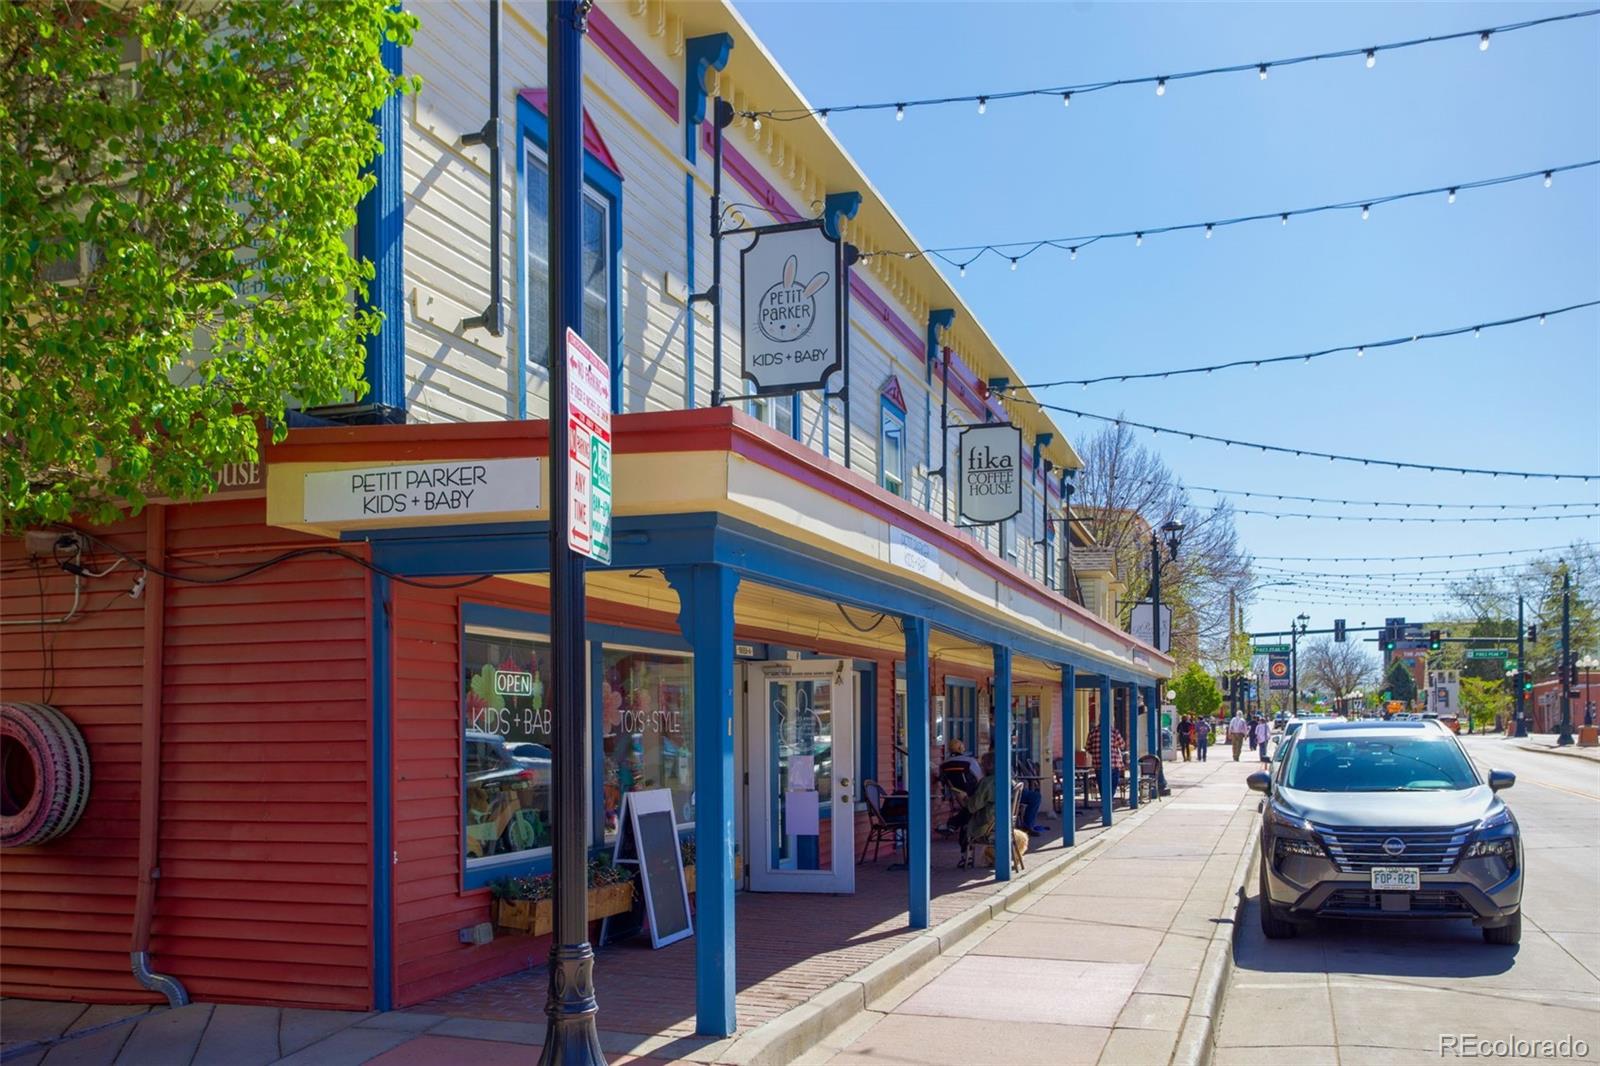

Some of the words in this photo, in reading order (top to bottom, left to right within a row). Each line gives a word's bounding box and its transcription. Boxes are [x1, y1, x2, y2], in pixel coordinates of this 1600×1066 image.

[752, 352, 783, 367] KIDS
[794, 348, 828, 363] BABY
[592, 445, 598, 479] 2
[968, 446, 1013, 470] fika
[351, 471, 402, 493] PETIT
[406, 465, 487, 490] PARKER
[575, 470, 586, 496] ANY
[968, 472, 1013, 484] COFFEE
[969, 482, 1012, 496] HOUSE
[363, 493, 406, 514] KIDS
[412, 497, 420, 506] +
[424, 489, 474, 511] BABY
[574, 498, 586, 525] TIME
[497, 674, 530, 692] OPEN
[472, 707, 510, 735] KIDS
[513, 714, 521, 728] +
[524, 708, 552, 735] BAB
[618, 710, 644, 732] TOYS
[652, 710, 680, 732] STYLE
